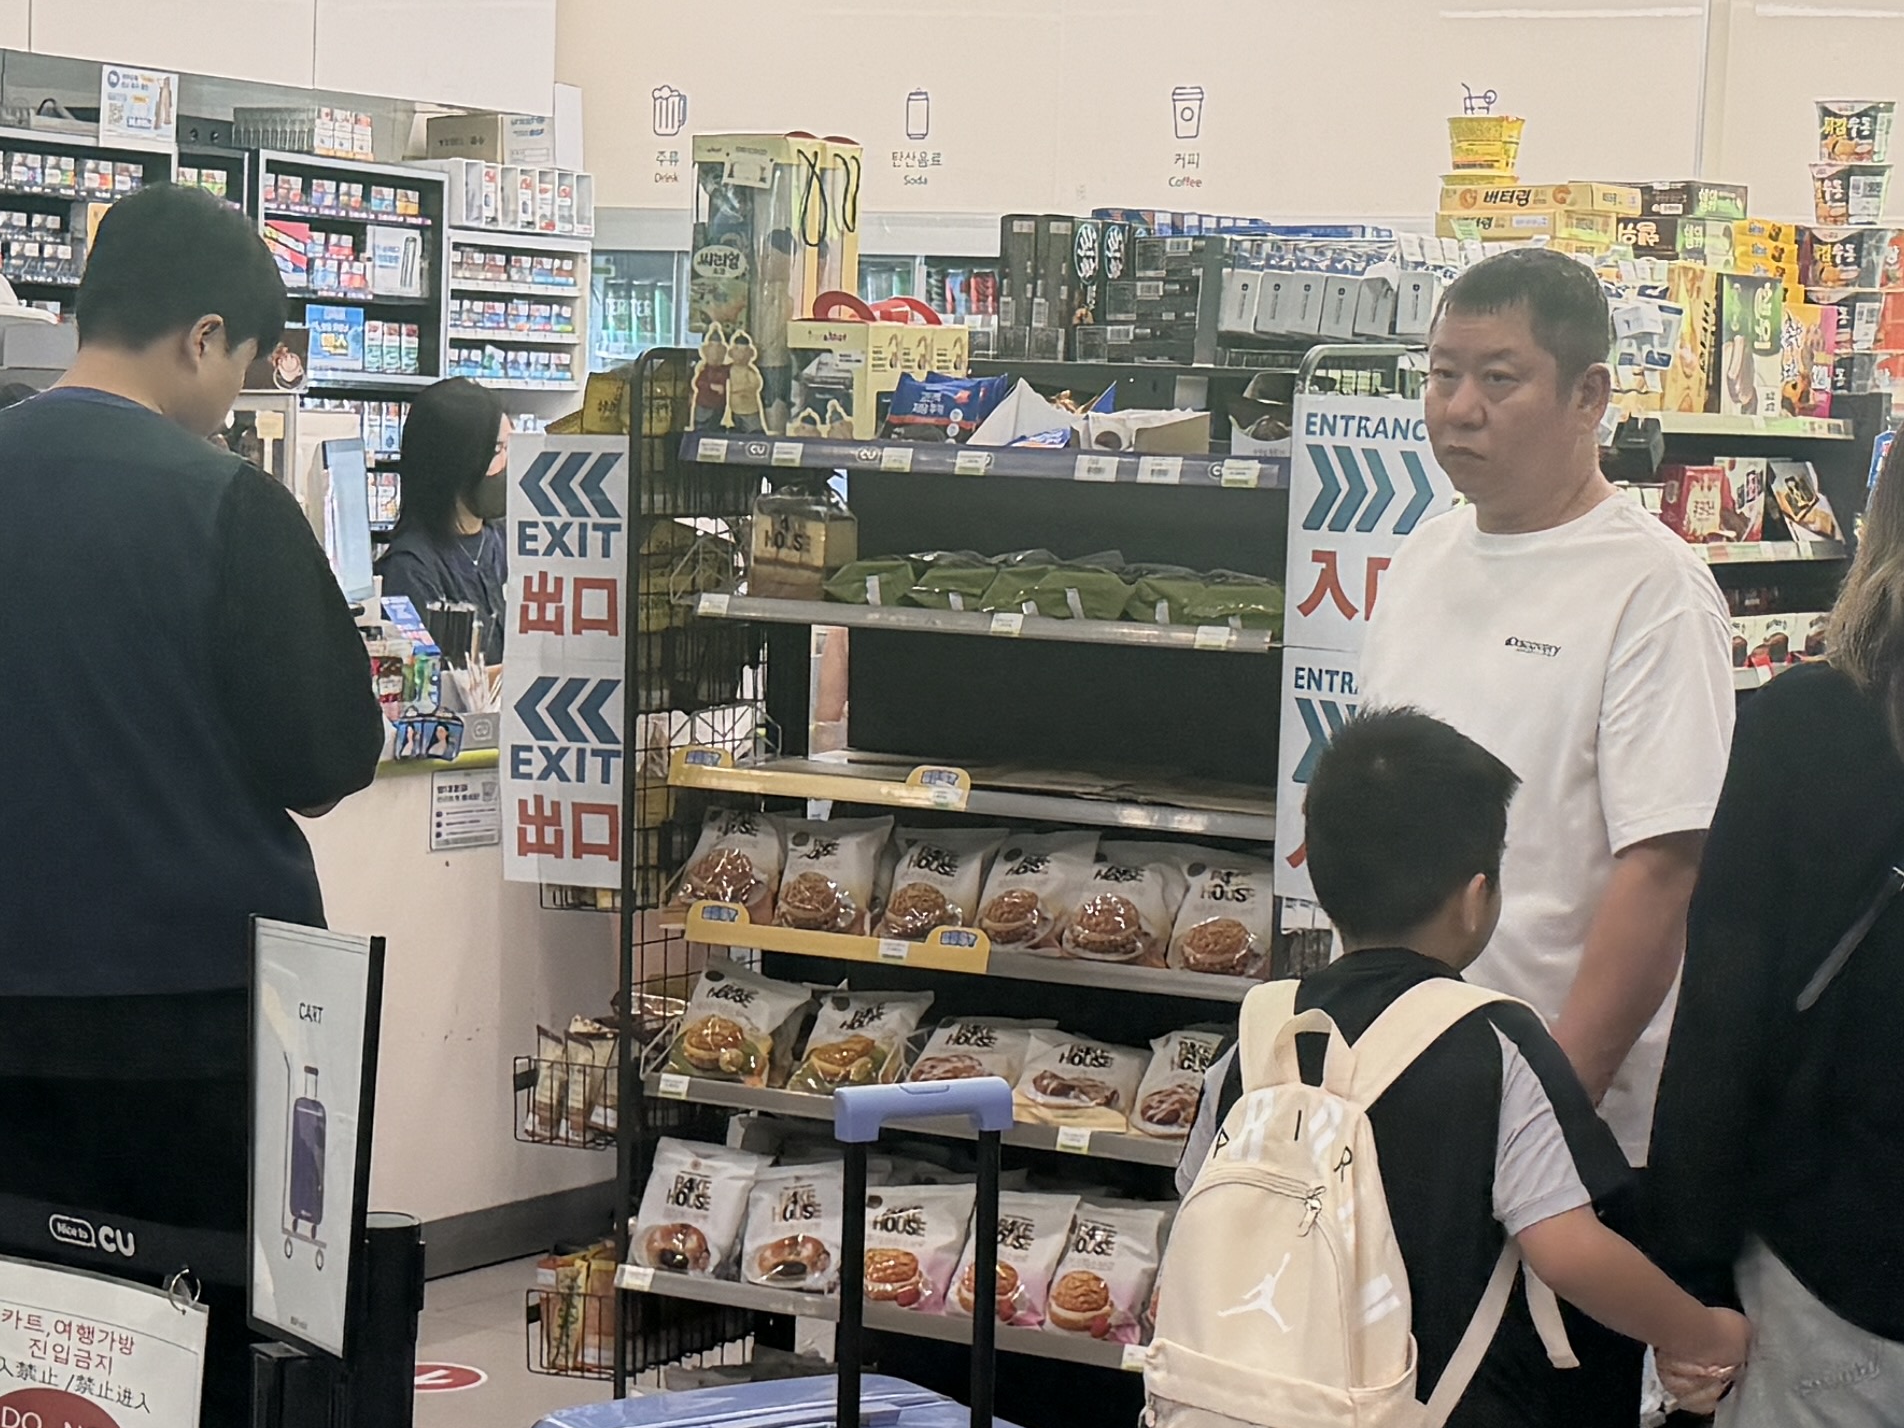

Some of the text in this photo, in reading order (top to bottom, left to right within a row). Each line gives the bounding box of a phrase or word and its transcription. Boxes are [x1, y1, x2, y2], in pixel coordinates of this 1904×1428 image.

[656, 150, 679, 167] 주류
[891, 151, 942, 168] 탄산음료
[1174, 152, 1201, 169] 커피
[654, 173, 679, 184] Drink
[903, 174, 928, 186] Soda
[1168, 176, 1203, 188] Coffee
[1483, 187, 1533, 207] 버터링
[1305, 412, 1426, 442] ENTRANC
[517, 520, 622, 558] EXIT
[518, 571, 619, 636] 出口
[1294, 667, 1358, 695] ENTR
[510, 745, 622, 785] EXIT
[517, 794, 619, 862] 出口
[298, 1002, 324, 1024] CART
[56, 1221, 135, 1257] Nice to CU
[1, 1309, 136, 1356] 카트,여행가방
[28, 1338, 113, 1375] 진입금지
